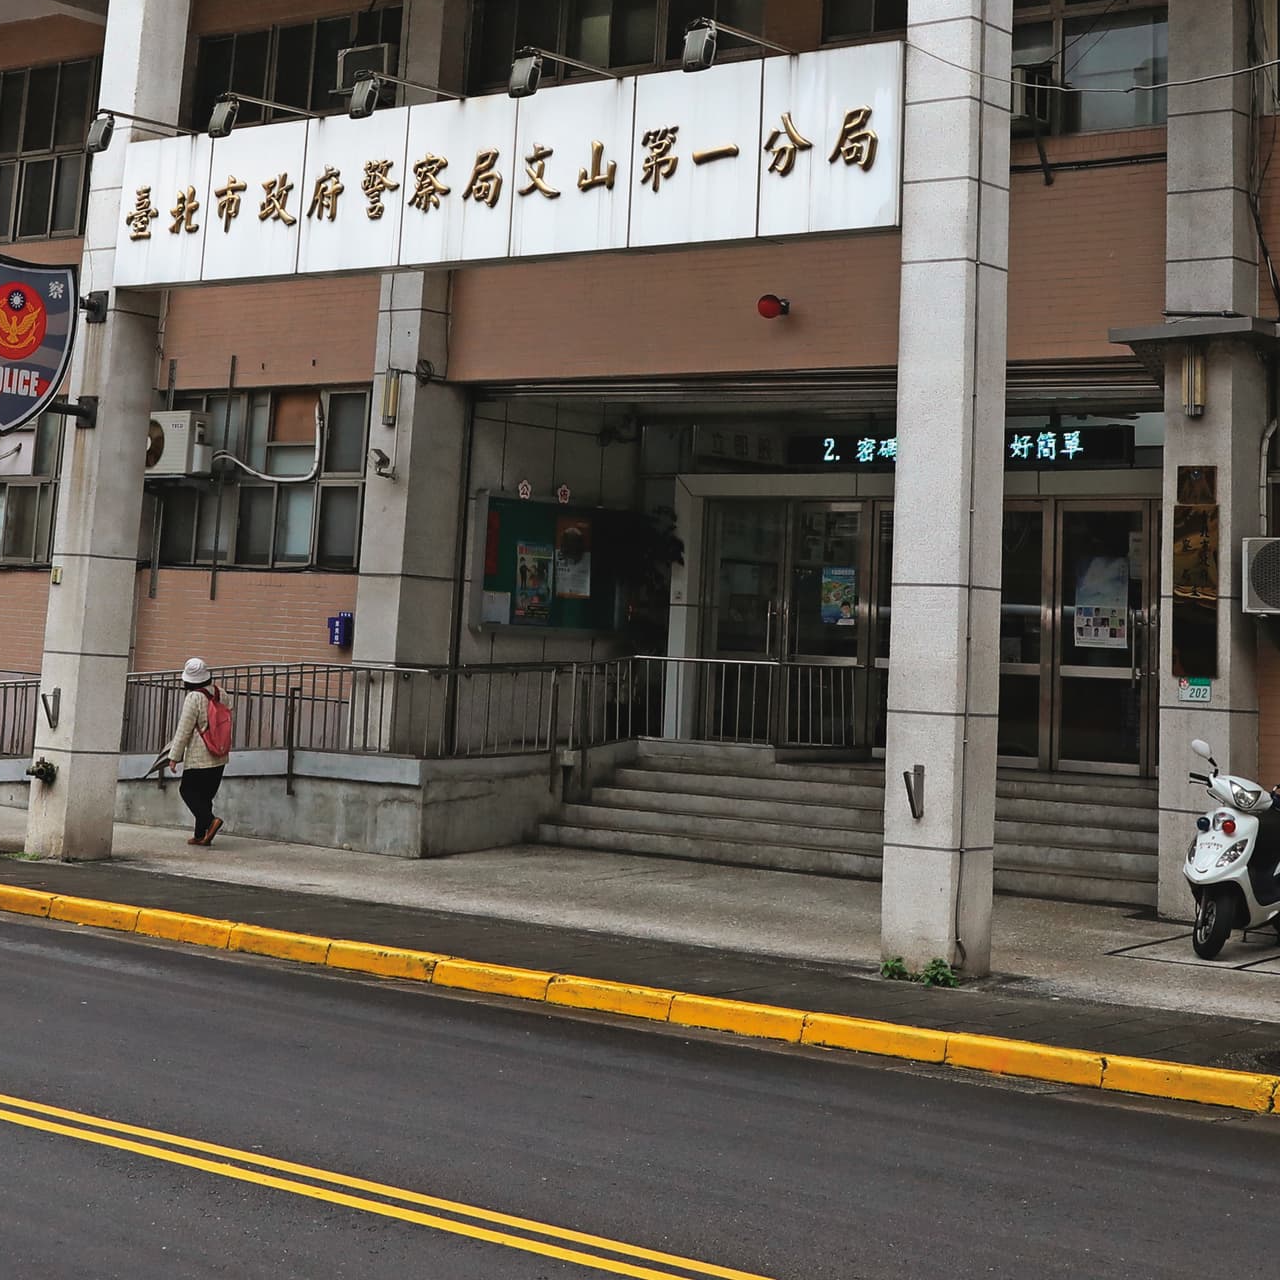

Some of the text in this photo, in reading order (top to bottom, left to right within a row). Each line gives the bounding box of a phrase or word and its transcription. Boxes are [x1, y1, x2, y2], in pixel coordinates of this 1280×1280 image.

[126, 104, 880, 240] 臺北市政府警察局文山第一分局
[1009, 430, 1084, 461] 好簡單
[1189, 687, 1208, 699] 202
